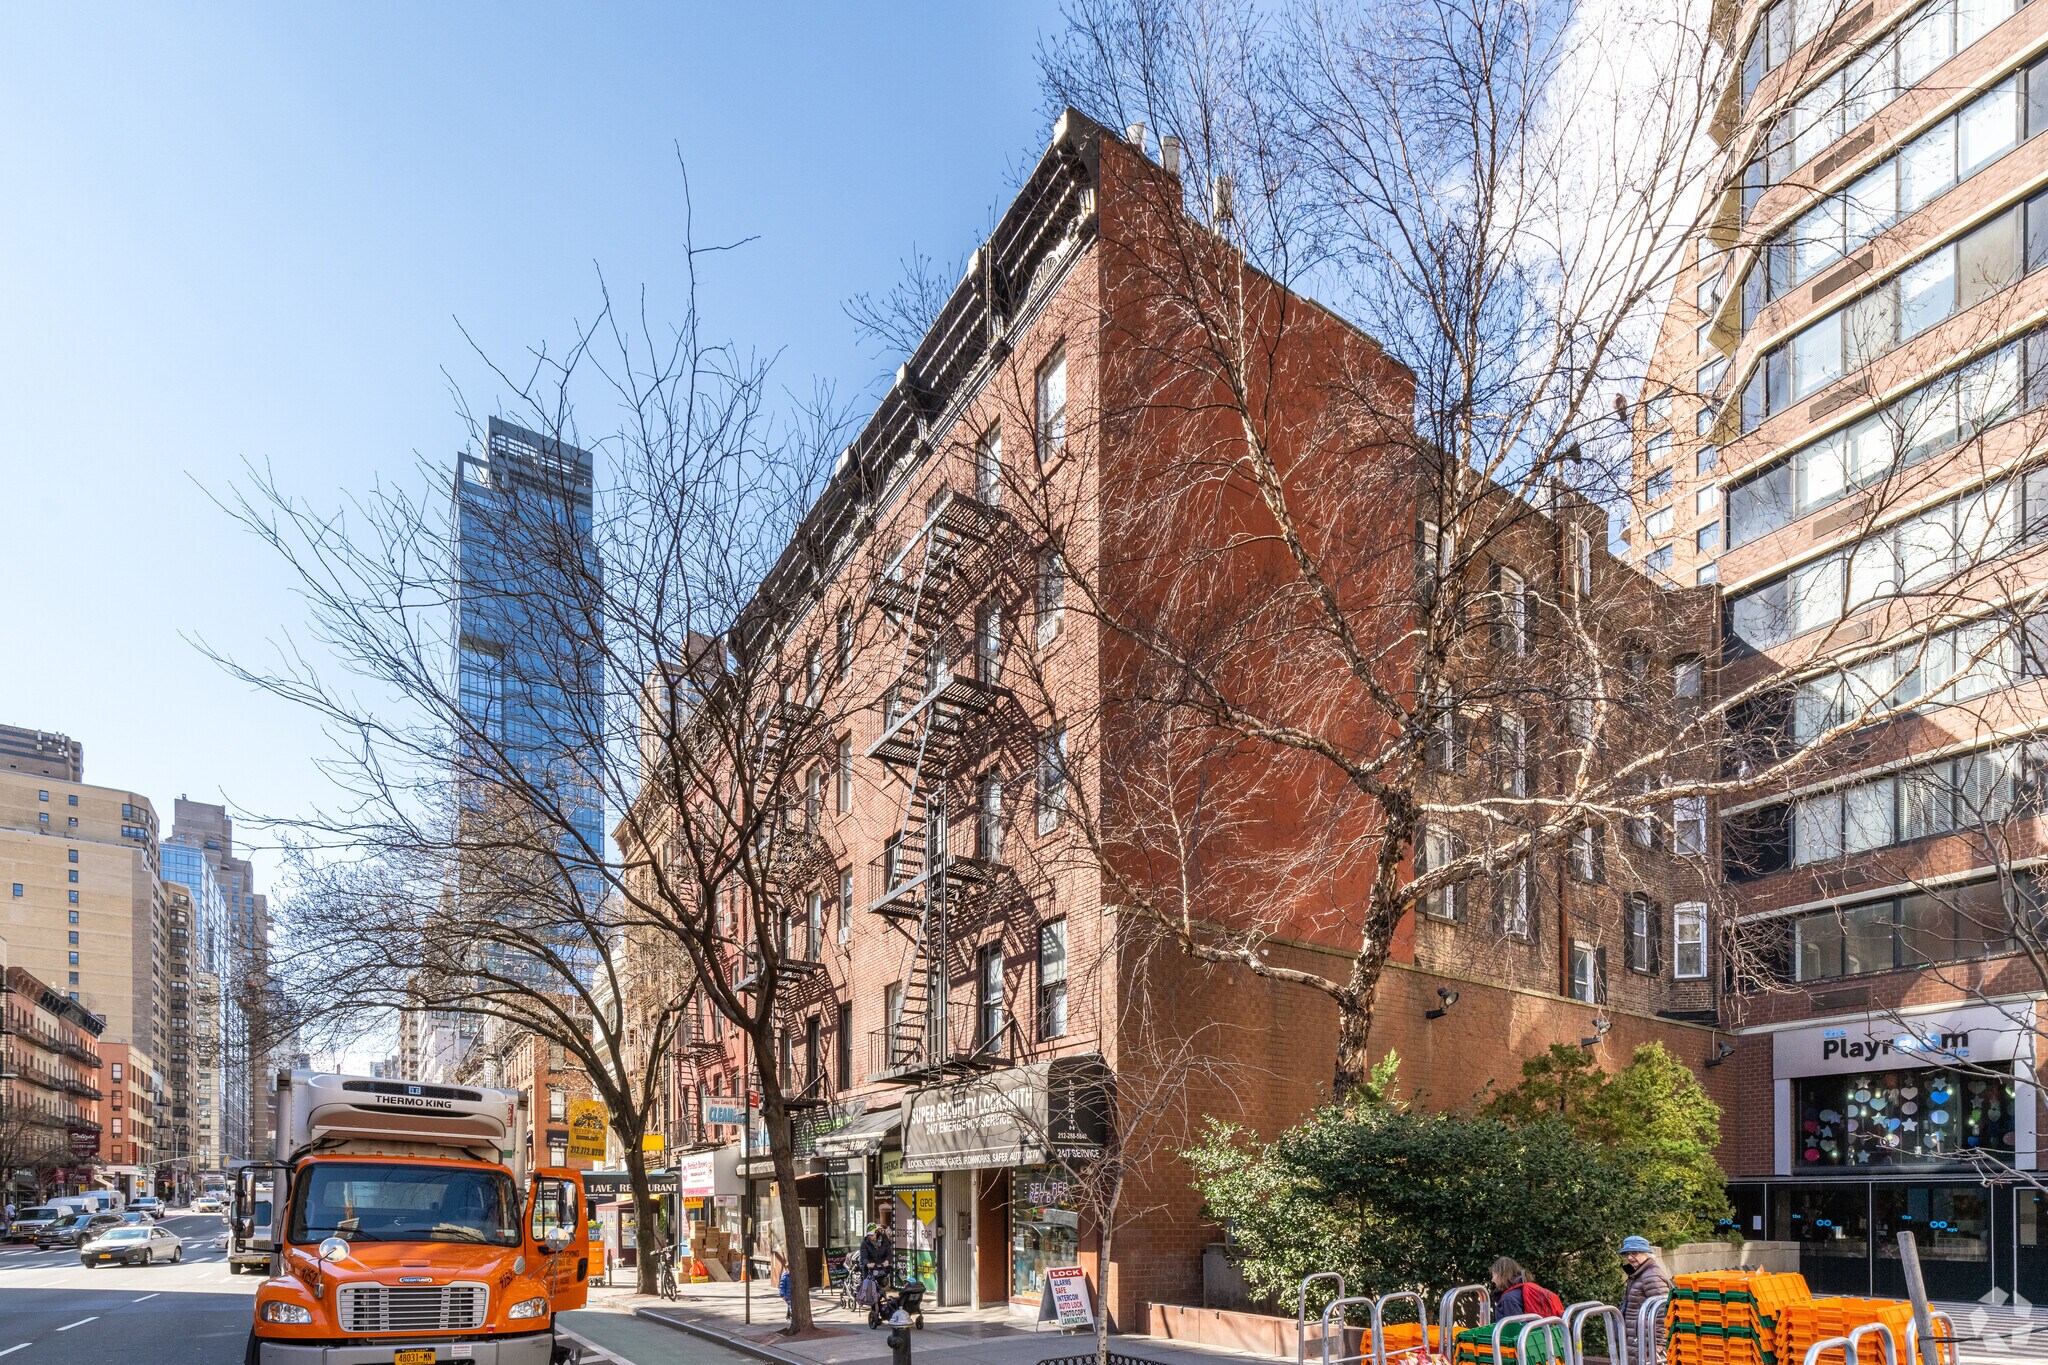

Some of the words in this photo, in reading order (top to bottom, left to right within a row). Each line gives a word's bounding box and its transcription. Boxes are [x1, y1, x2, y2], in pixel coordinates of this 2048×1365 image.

[1823, 1028, 1846, 1039] the
[375, 1095, 424, 1107] THERMO
[425, 1100, 452, 1109] KING
[911, 1104, 936, 1124] SUPER
[937, 1096, 977, 1120] SECURITY
[978, 1087, 1033, 1113] LOCKSMITH
[926, 1123, 938, 1135] 24/7
[939, 1118, 980, 1133] EMERGENCY
[981, 1112, 1012, 1129] SERVICE
[1072, 1149, 1100, 1159] SERVICE
[620, 1183, 678, 1192] REURANT
[920, 1199, 933, 1207] GPG
[896, 1228, 913, 1238] STORE
[921, 1229, 933, 1239] FOR
[1057, 1294, 1078, 1302] INTERCOM
[1062, 1317, 1087, 1325] LAMINATION
